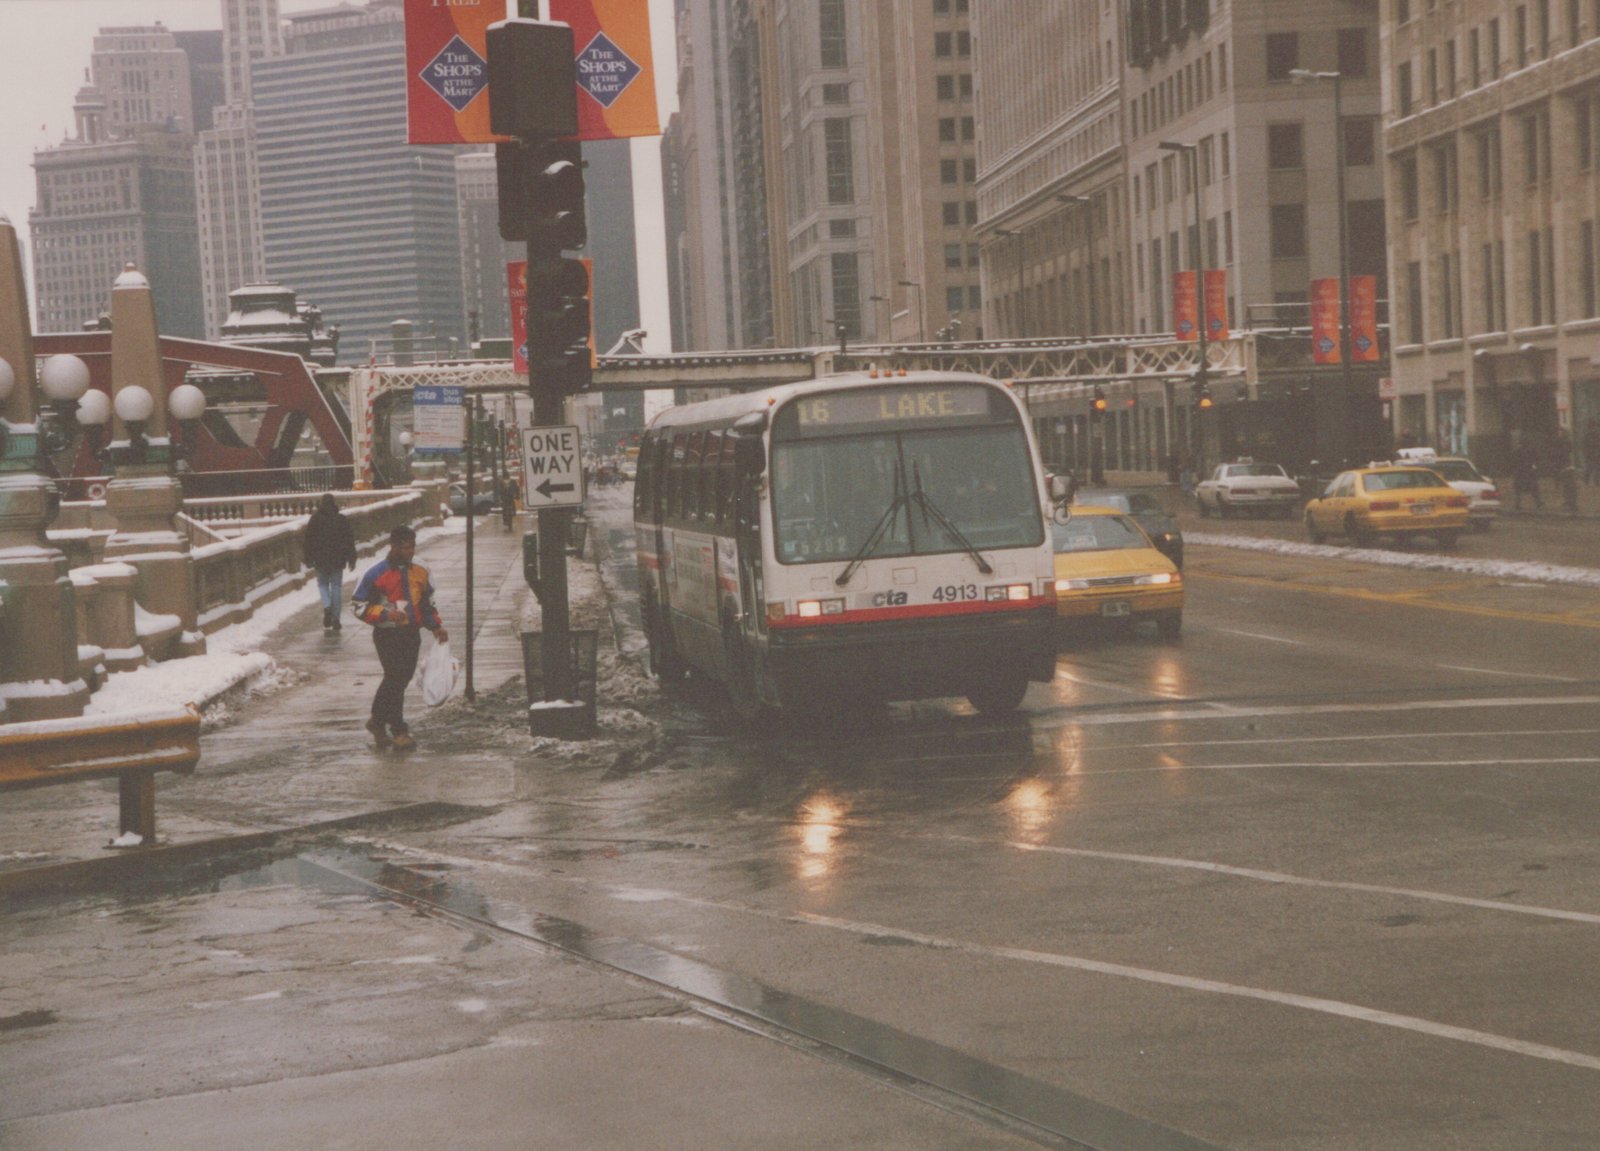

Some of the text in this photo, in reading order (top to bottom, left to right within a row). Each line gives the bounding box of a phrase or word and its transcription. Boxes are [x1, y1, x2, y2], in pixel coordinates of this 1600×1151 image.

[443, 52, 470, 63] THE
[588, 49, 614, 60] THE
[433, 62, 482, 77] SHOPS
[579, 59, 628, 74] SHOPS
[797, 391, 954, 424] 16 LAKE
[530, 433, 573, 453] ONE
[530, 454, 574, 475] WAY
[872, 589, 908, 607] cta
[932, 584, 978, 602] 4913
